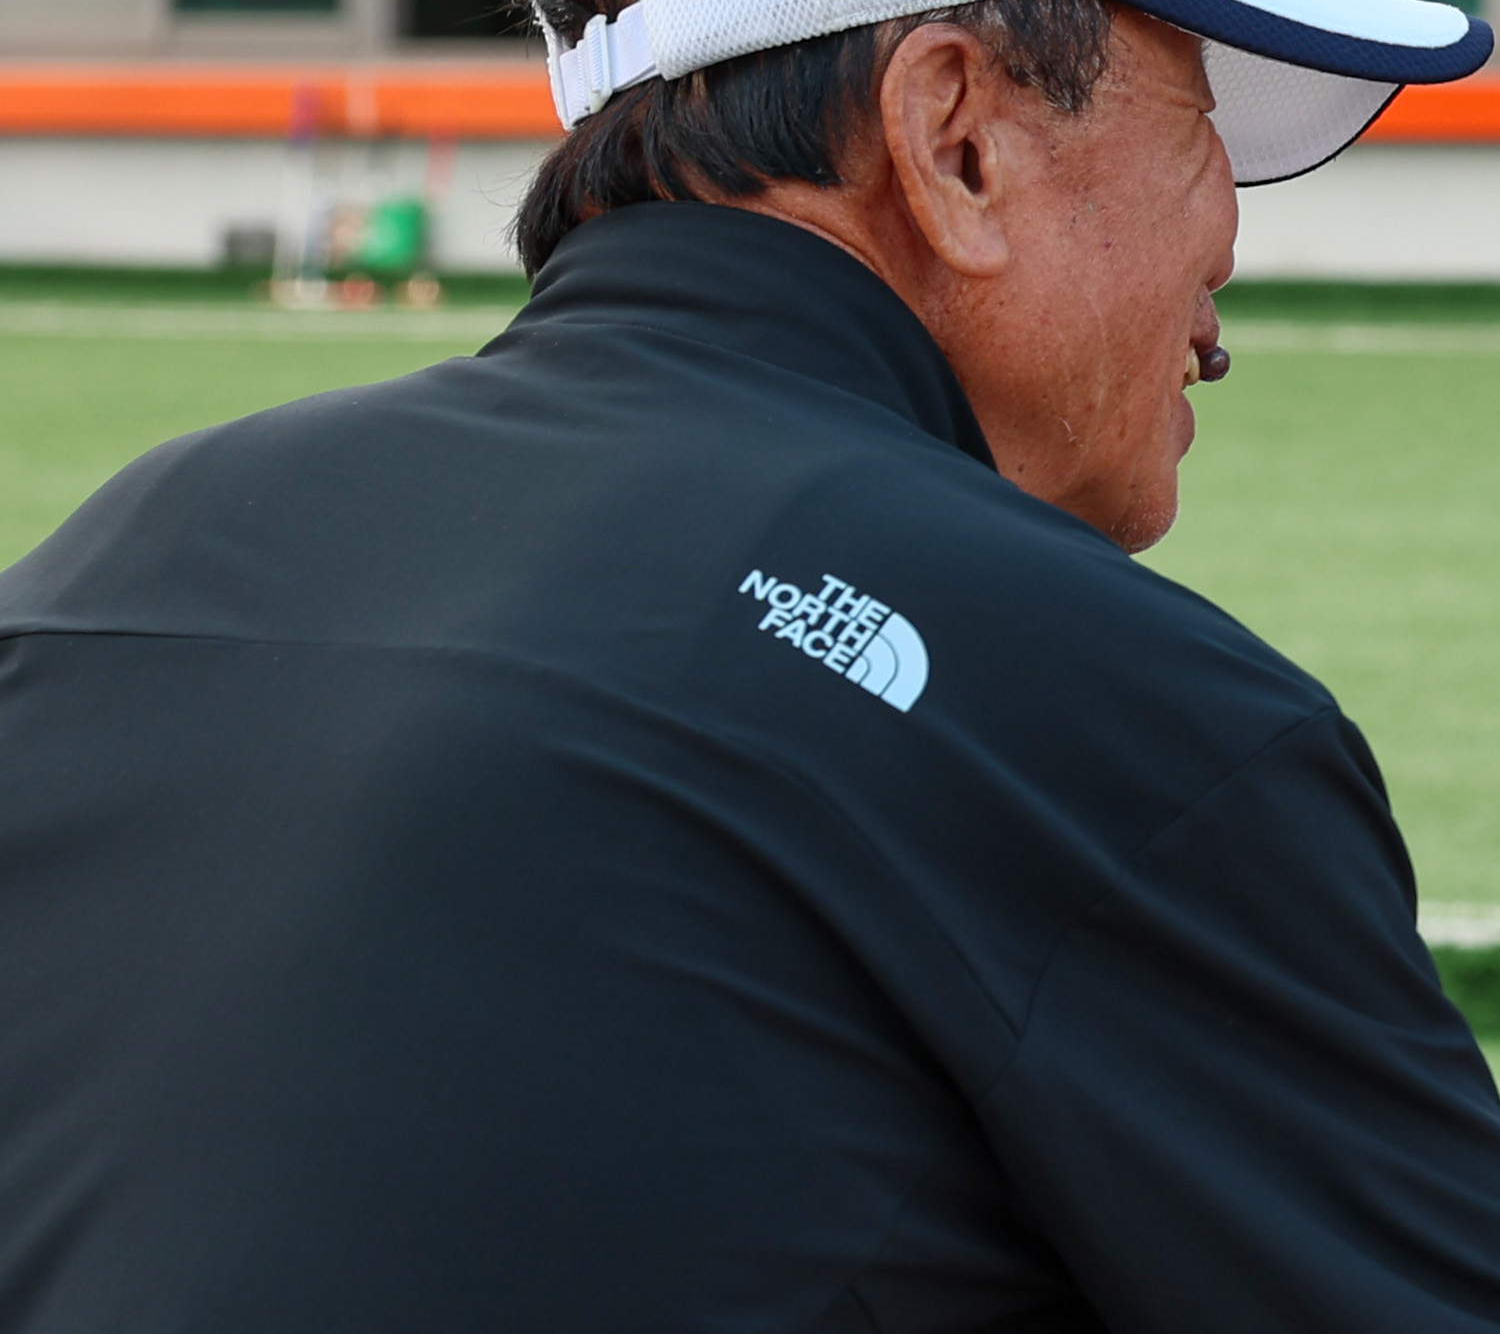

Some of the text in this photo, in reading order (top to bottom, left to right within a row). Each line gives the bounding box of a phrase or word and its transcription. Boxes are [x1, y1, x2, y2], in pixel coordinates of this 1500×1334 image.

[738, 568, 873, 652] NORTH
[818, 573, 891, 630] THE
[758, 608, 854, 674] FACE
